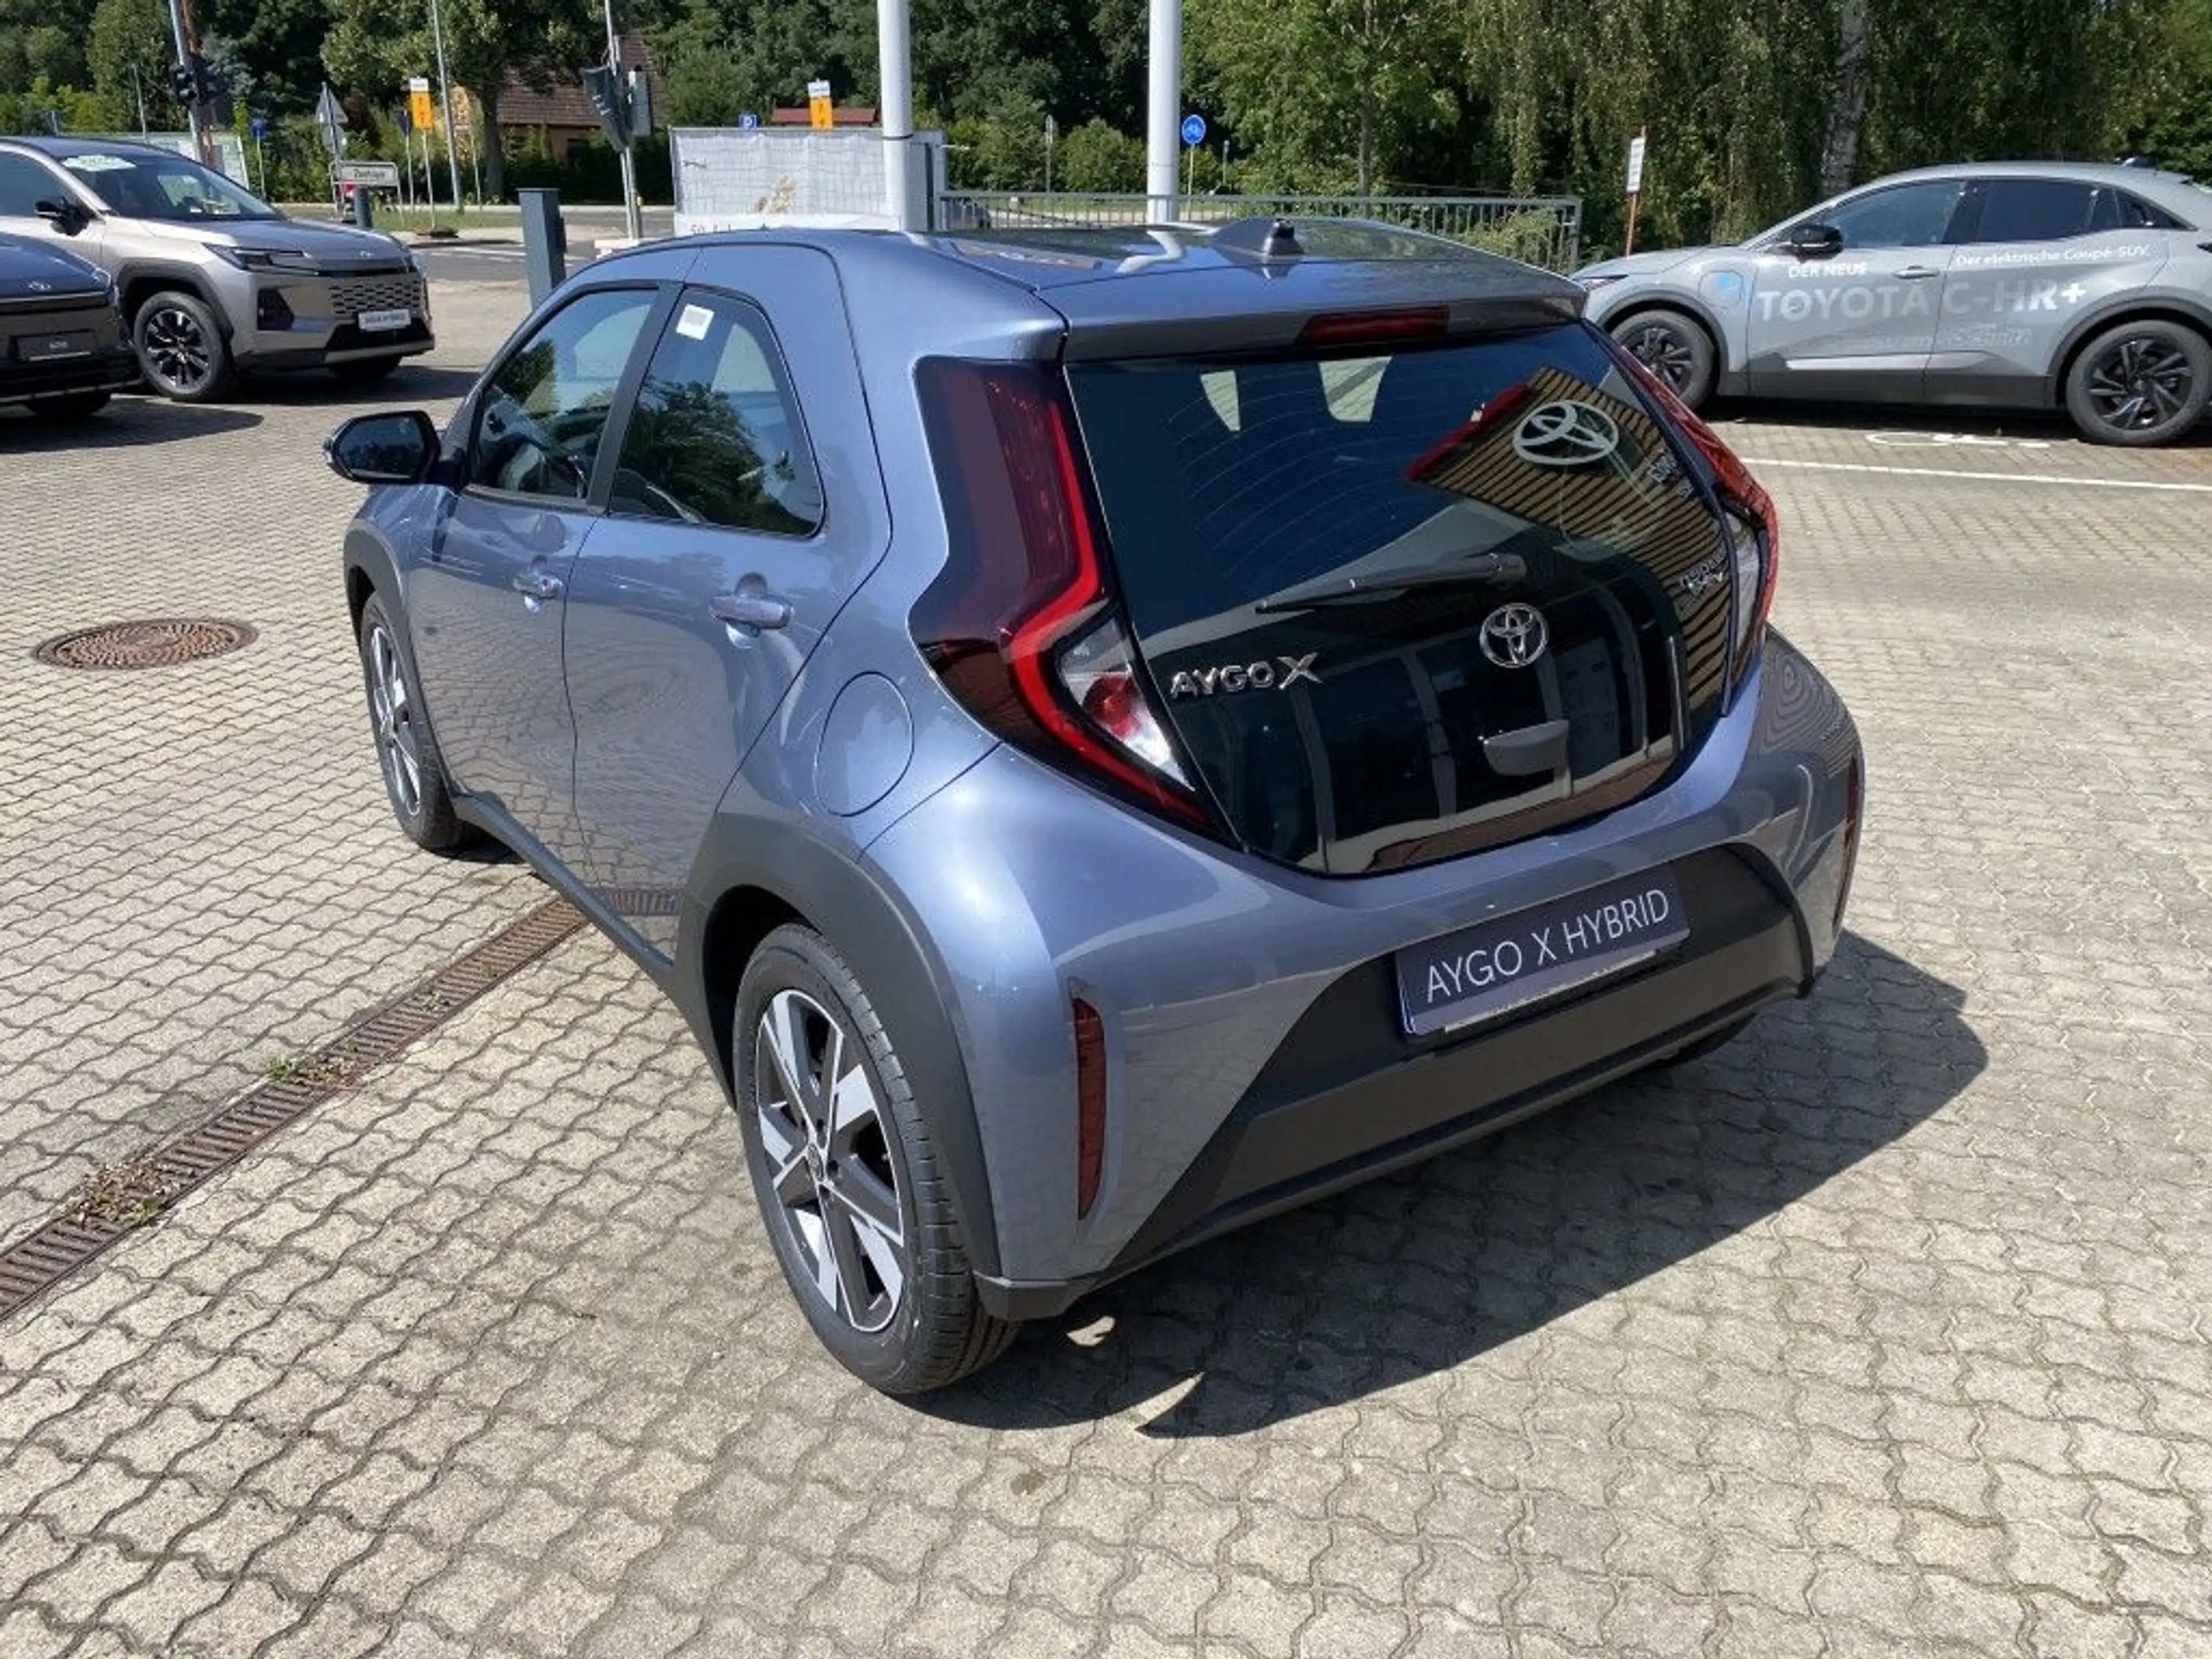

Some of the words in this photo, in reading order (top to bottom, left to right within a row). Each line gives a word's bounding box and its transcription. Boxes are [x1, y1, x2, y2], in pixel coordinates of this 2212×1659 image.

[1788, 266, 1820, 278] DER
[1822, 261, 1868, 276] NEUE
[1758, 286, 1930, 322] TOYOTA
[1944, 279, 2086, 315] C-HR+
[1426, 941, 1522, 1003] AYGO
[1531, 926, 1557, 966] X
[1562, 889, 1669, 954] HYBRID
